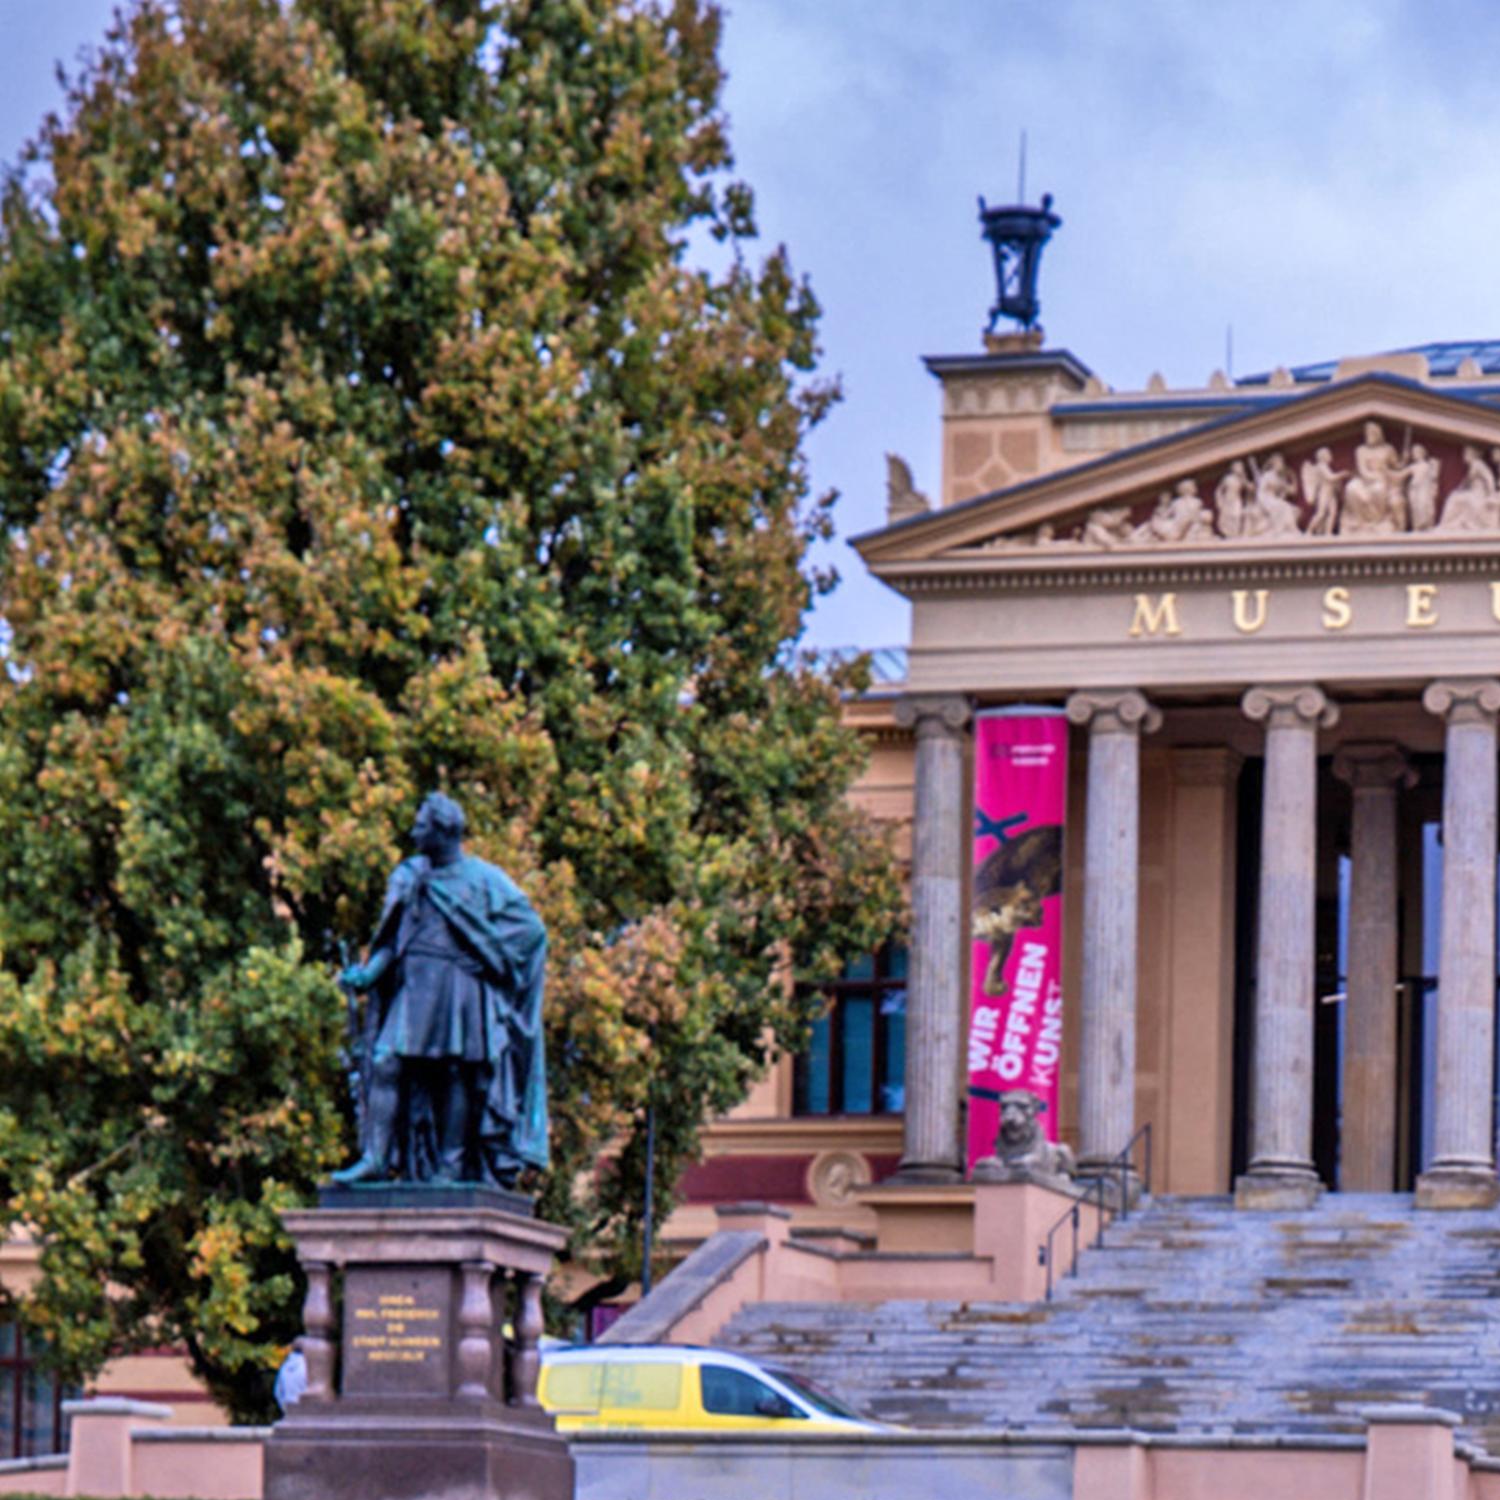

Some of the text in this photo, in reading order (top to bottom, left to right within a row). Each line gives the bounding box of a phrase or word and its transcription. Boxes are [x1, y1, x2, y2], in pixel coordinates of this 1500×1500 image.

[968, 1005, 1001, 1073] WIR
[990, 941, 1048, 1081] ÖFFNEN
[1029, 979, 1063, 1086] KUNST
